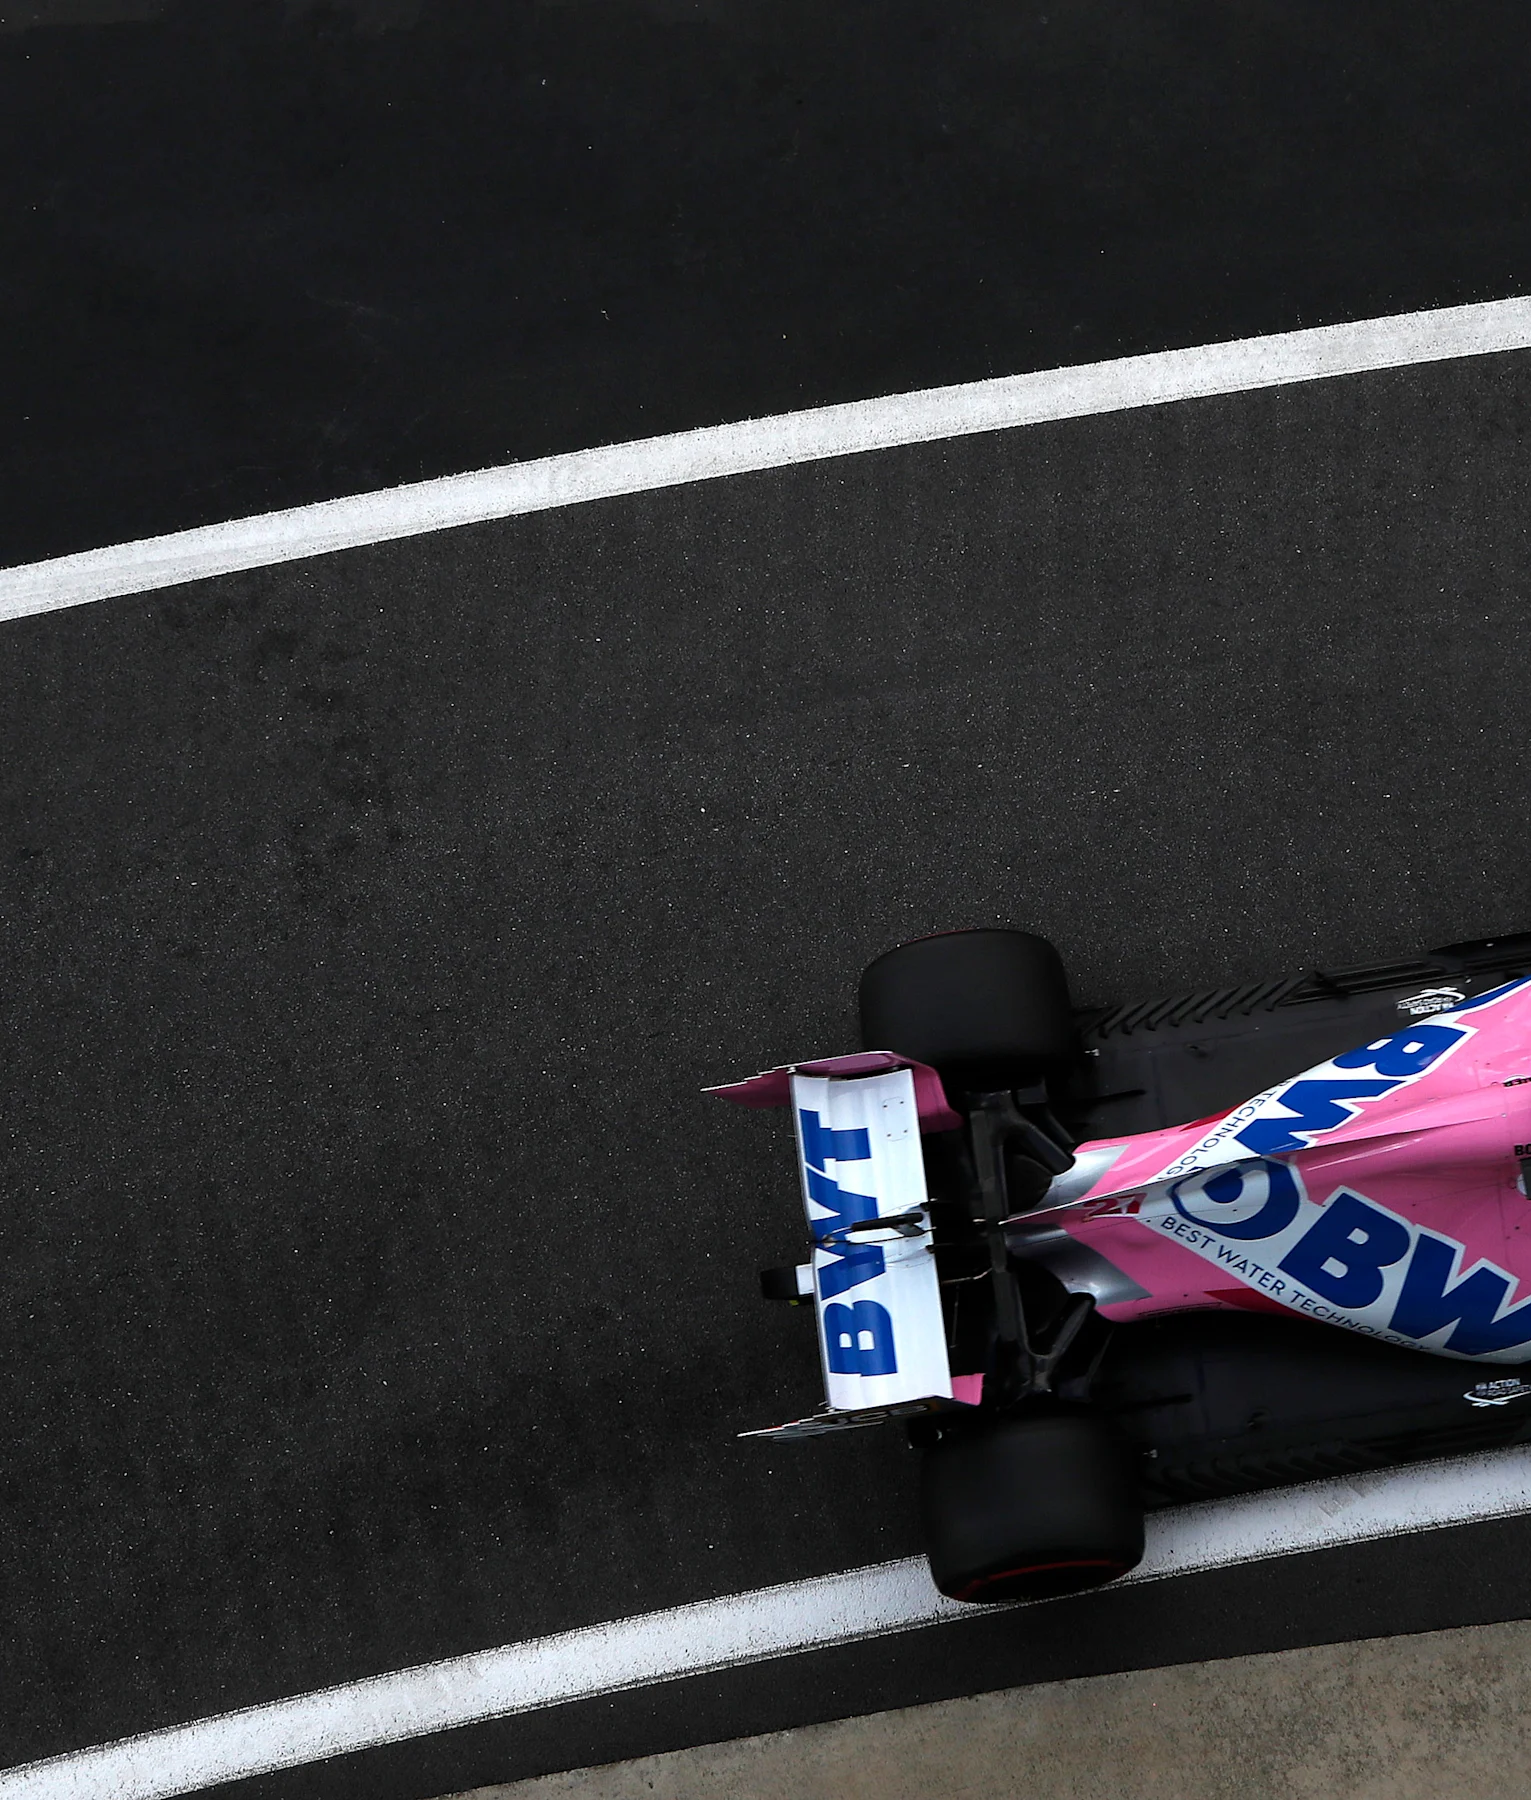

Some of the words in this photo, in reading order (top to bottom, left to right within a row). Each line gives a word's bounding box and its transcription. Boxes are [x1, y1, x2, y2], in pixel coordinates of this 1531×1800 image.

[1157, 1089, 1278, 1180] TECHNOLOG
[1160, 1216, 1215, 1249] BEST
[1217, 1245, 1286, 1297] WATER
[1289, 1292, 1432, 1352] TECHNOLOGY
